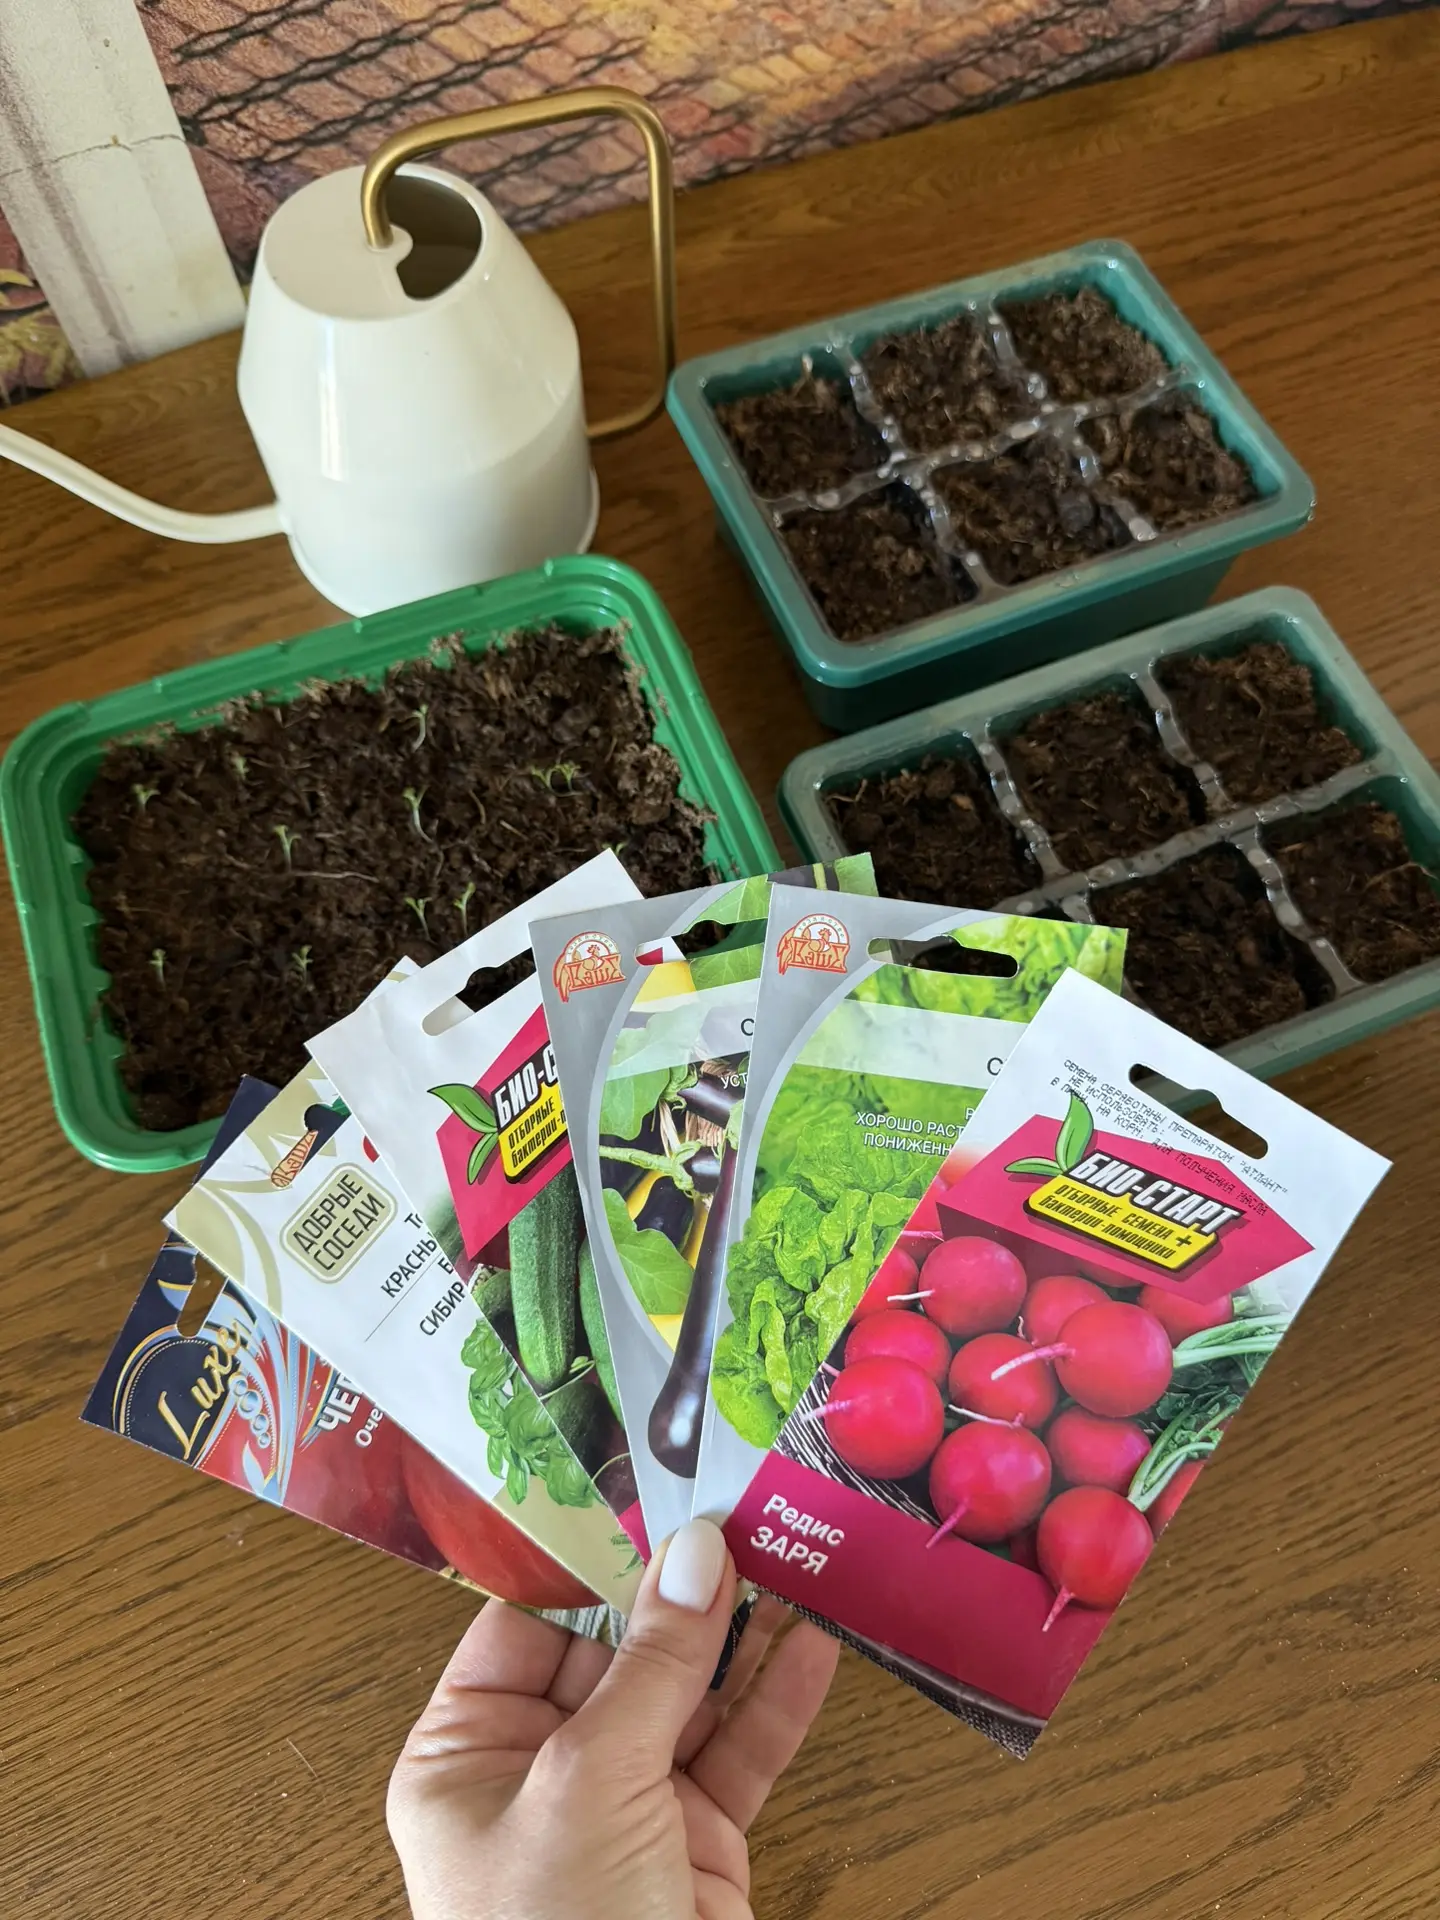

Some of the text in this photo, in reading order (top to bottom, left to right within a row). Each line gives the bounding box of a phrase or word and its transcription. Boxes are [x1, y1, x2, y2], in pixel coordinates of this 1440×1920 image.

[1068, 1074, 1085, 1089] НЕ
[508, 1096, 555, 1150] ОТБОРНЫЕ
[856, 1111, 923, 1133] ХОРОШО
[1063, 1059, 1098, 1085] СЕМЕНА
[1100, 1083, 1167, 1125] ОБРАБОТАНЫ
[1168, 1120, 1235, 1163] ПРЕПАРАТОМ
[1096, 1103, 1112, 1118] НА
[1174, 1152, 1236, 1194] ПОЛУЧЕНИЯ
[293, 1173, 364, 1255] ДОБРЫЕ
[1055, 1184, 1123, 1218] ОТБОРНЫЕ
[1121, 1212, 1175, 1241] СЕМЕНА
[1069, 1152, 1241, 1235] БИО-СТАРТ
[313, 1192, 386, 1271] СОСЕДИ
[1038, 1195, 1177, 1260] бактерии-помощники
[419, 1281, 466, 1336] СИБИР
[762, 1493, 845, 1547] Редис
[750, 1526, 829, 1576] ЗАРЯ
